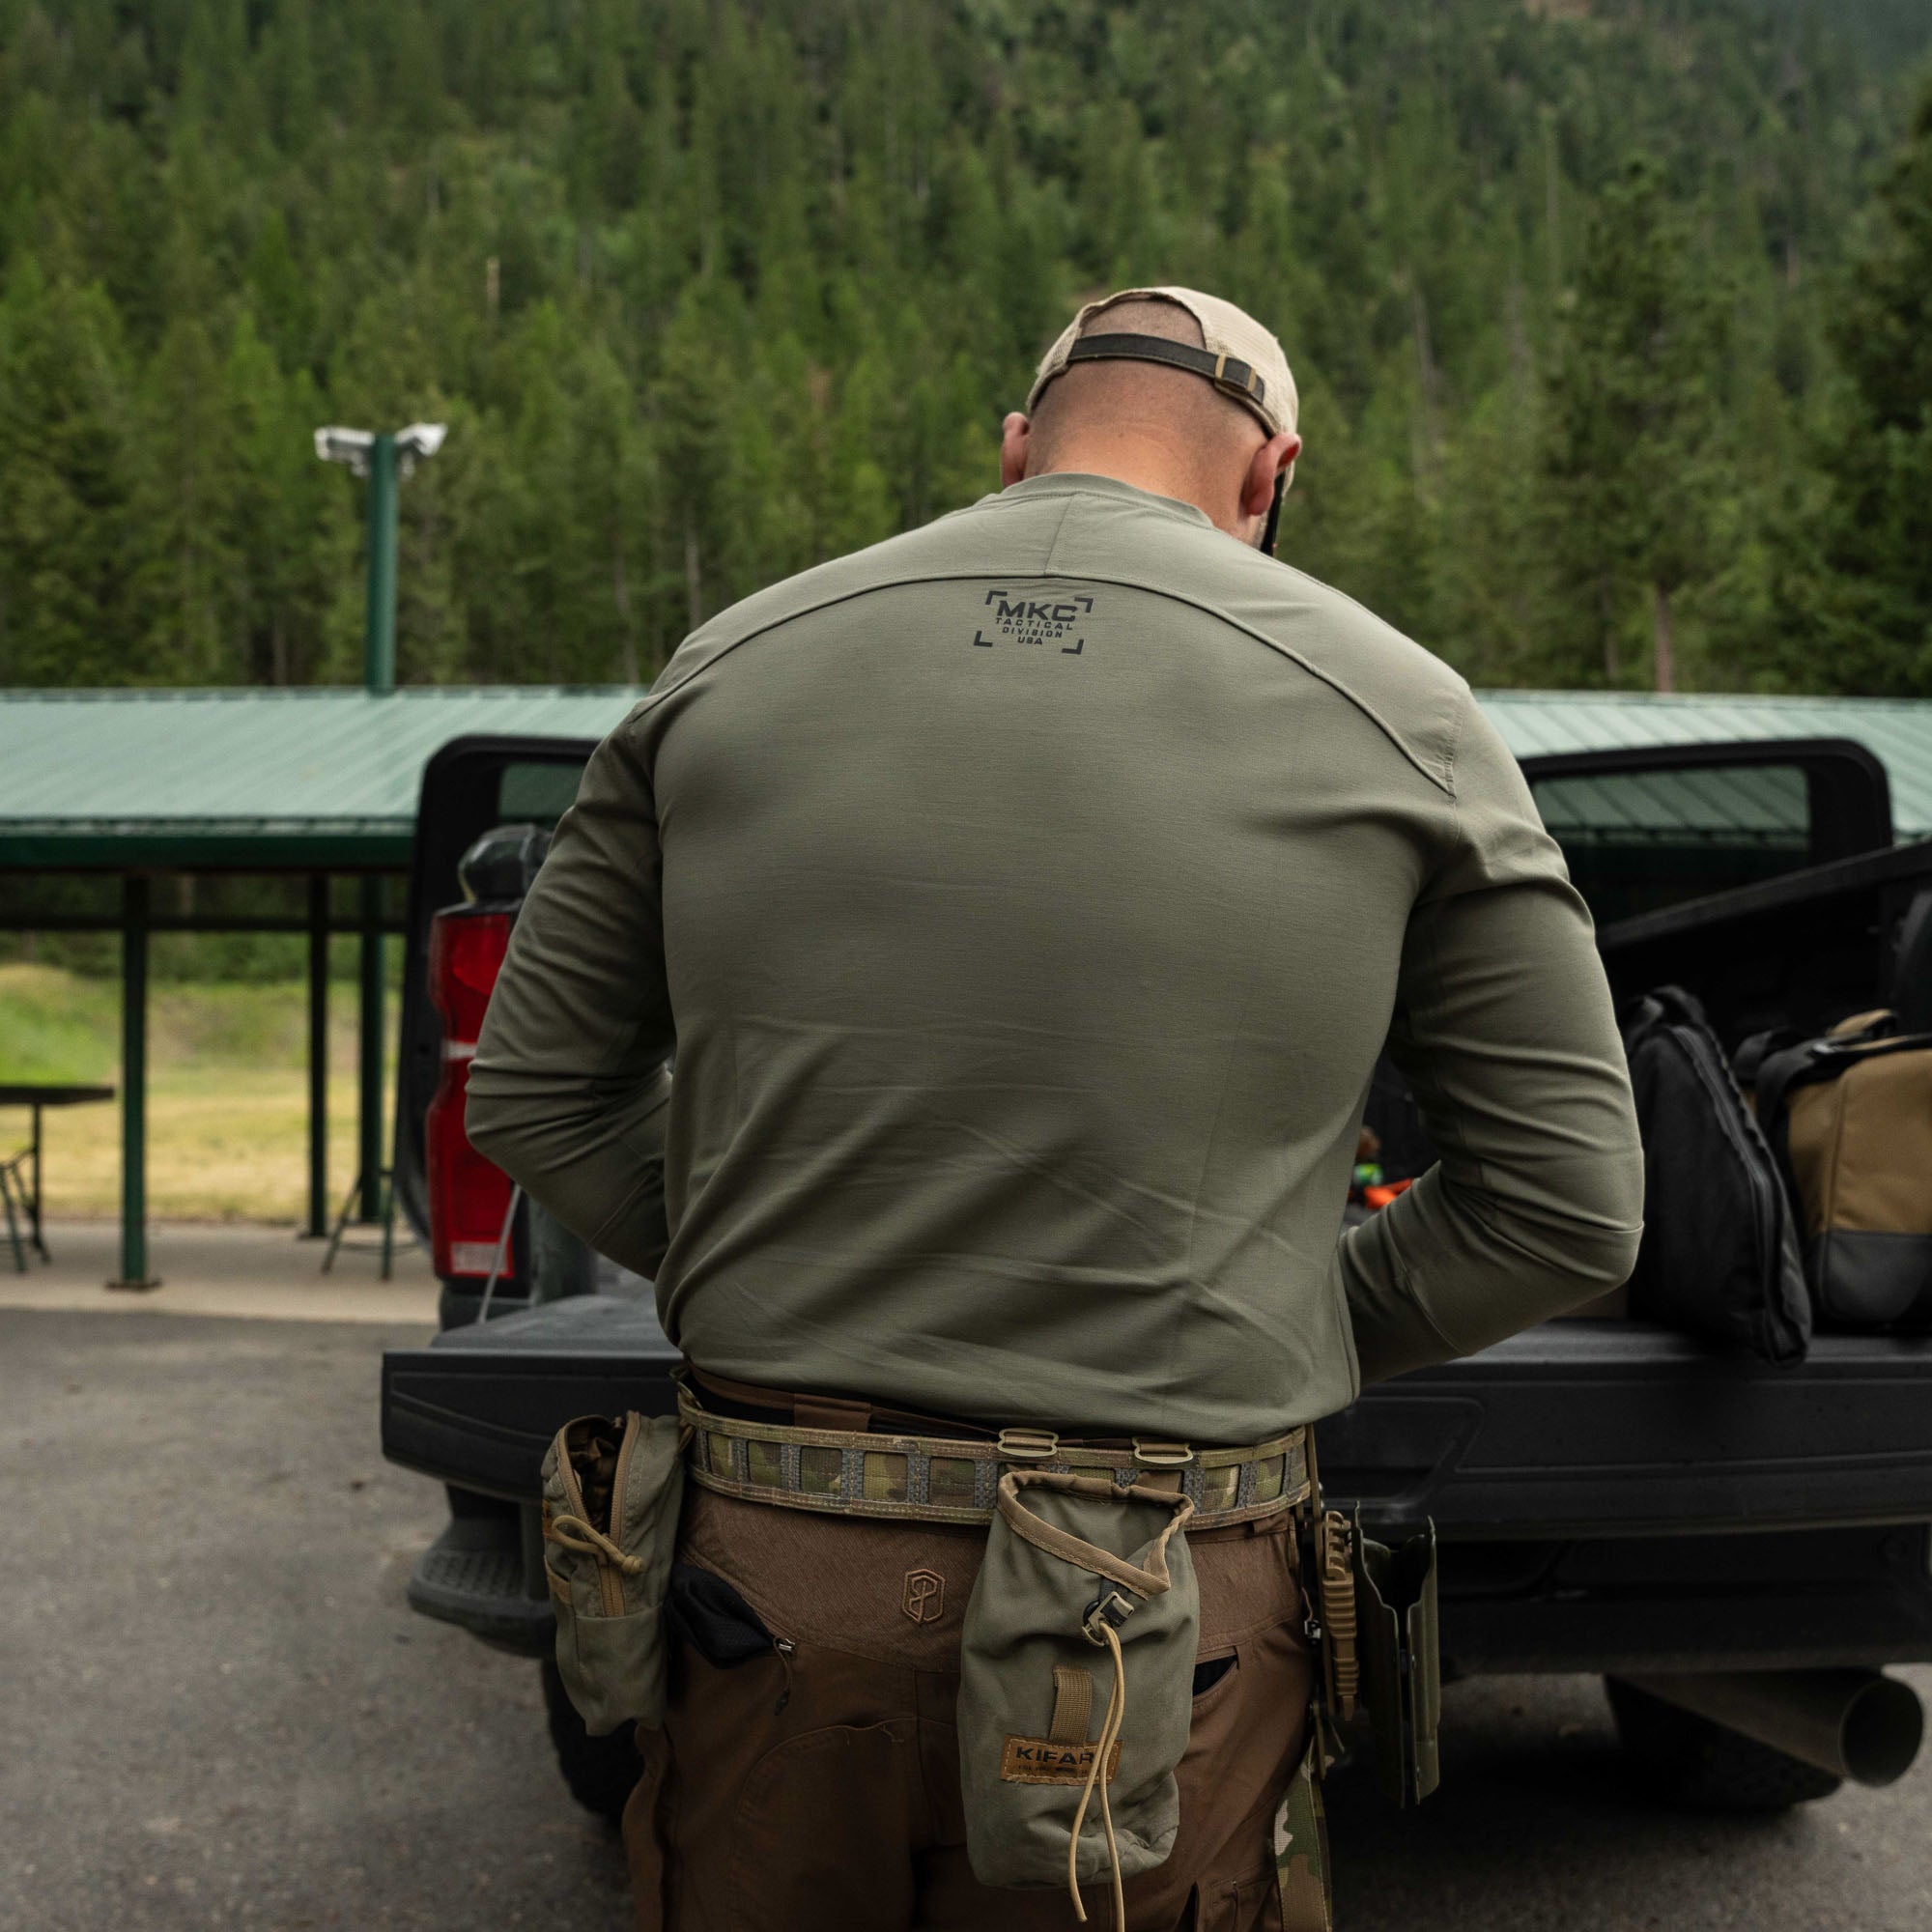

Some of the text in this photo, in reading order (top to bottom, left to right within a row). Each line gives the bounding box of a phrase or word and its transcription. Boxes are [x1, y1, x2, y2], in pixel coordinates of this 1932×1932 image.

[997, 600, 1078, 622] MKC
[996, 617, 1073, 631] TACTICAL
[1002, 626, 1063, 639] DIVISION
[1017, 636, 1043, 645] USA
[1015, 1746, 1098, 1765] KIFAR
